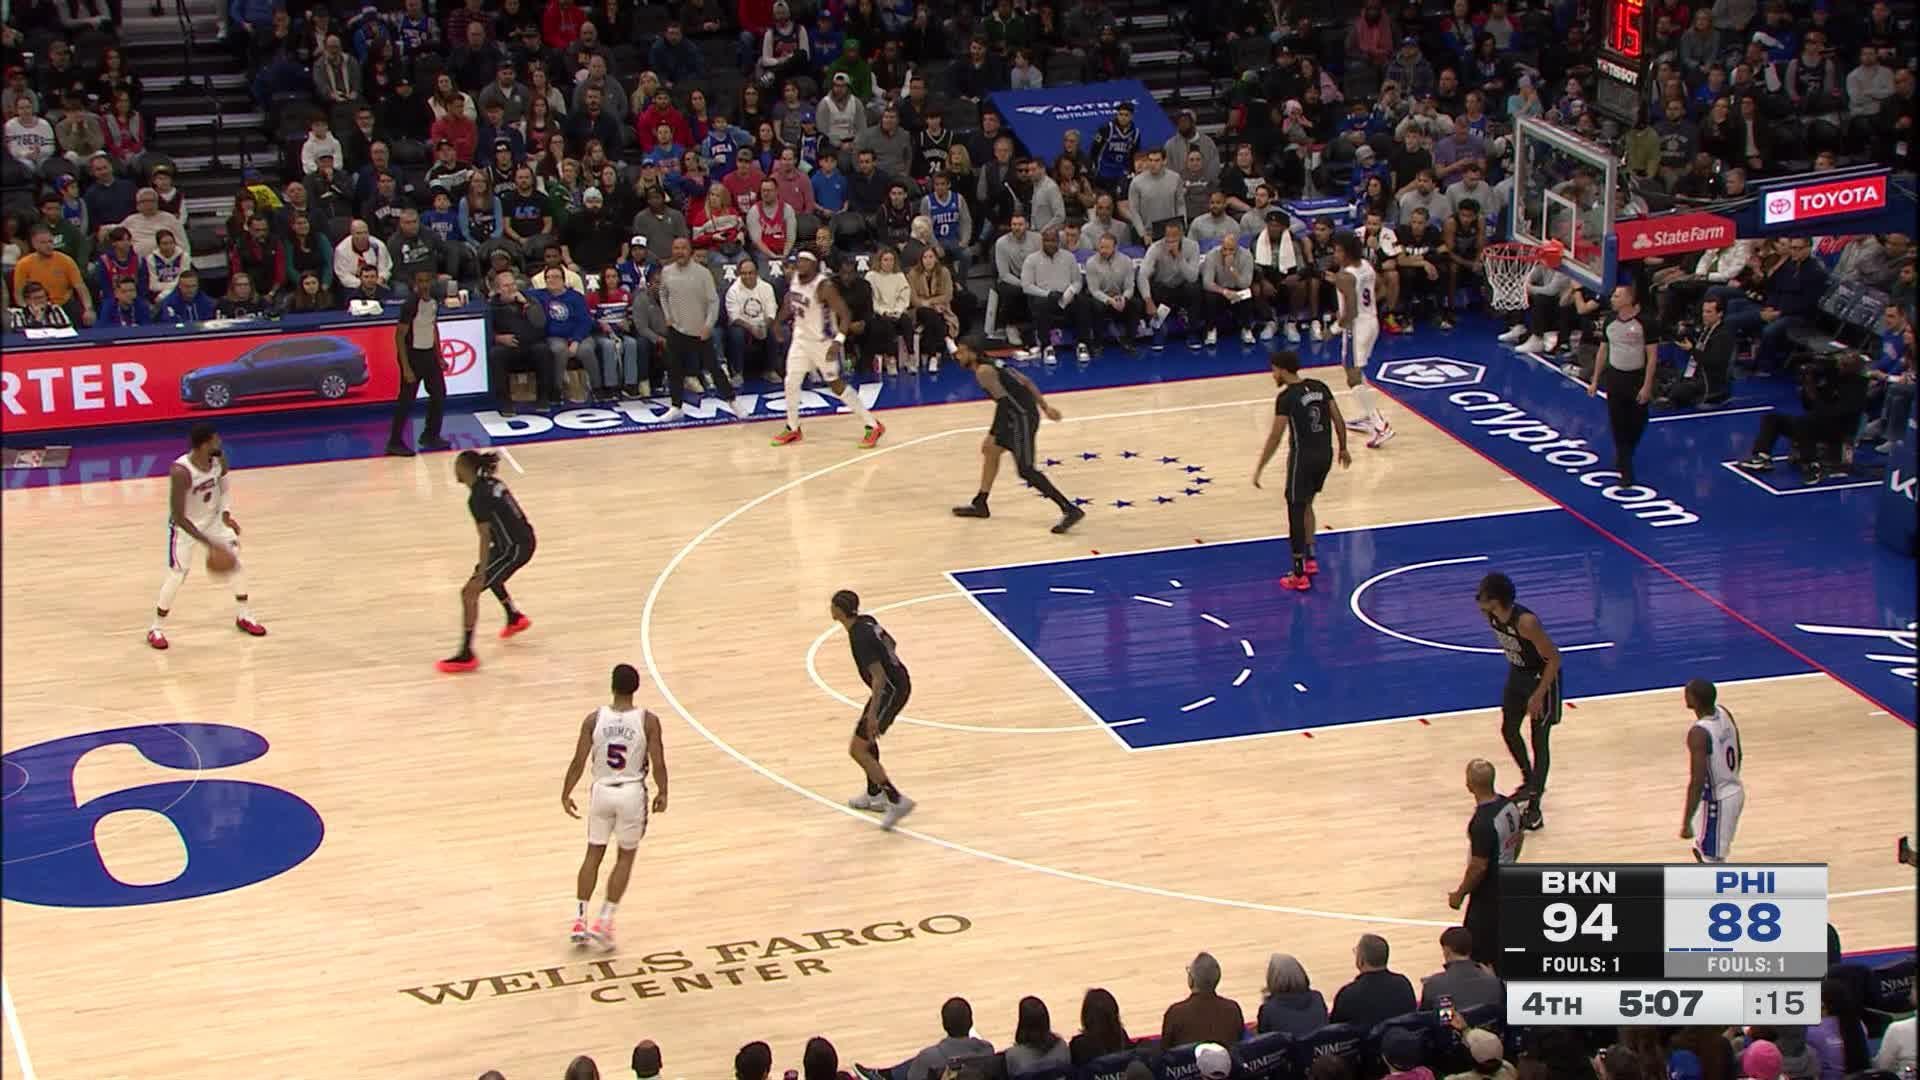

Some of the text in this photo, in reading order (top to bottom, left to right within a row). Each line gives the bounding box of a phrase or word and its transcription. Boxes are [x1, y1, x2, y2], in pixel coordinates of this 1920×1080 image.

[1615, 2, 1641, 58] 15
[1052, 99, 1139, 113] AMTRA
[1800, 185, 1878, 210] TOYOTA
[1362, 288, 1371, 307] 9
[2, 361, 153, 416] RTER
[473, 383, 883, 437] betway
[1449, 390, 1700, 527] crypto.com
[607, 744, 627, 770] 5
[1726, 746, 1736, 771] 0
[400, 914, 972, 1006] WELLS FARGO
[590, 958, 832, 1004] CENTER
